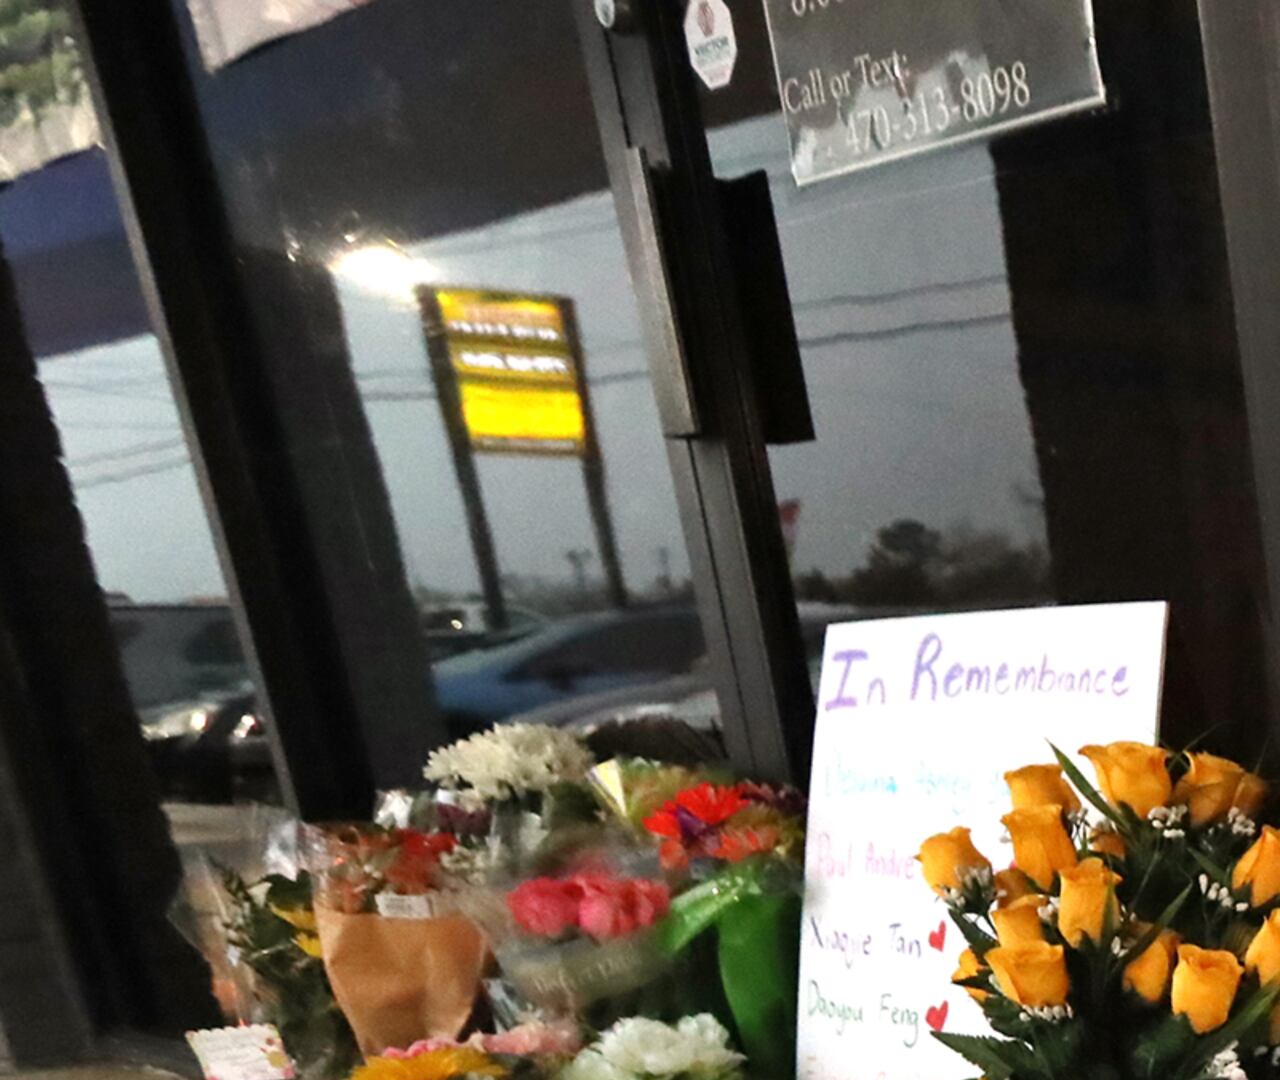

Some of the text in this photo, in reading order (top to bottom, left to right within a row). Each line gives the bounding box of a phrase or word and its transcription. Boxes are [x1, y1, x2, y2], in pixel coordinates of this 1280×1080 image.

[783, 68, 826, 114] Call
[829, 72, 851, 99] or
[846, 61, 1030, 154] 470-313-8098
[825, 632, 1131, 711] In Remembrance
[888, 921, 922, 958] Tan
[880, 993, 919, 1048] Feng
